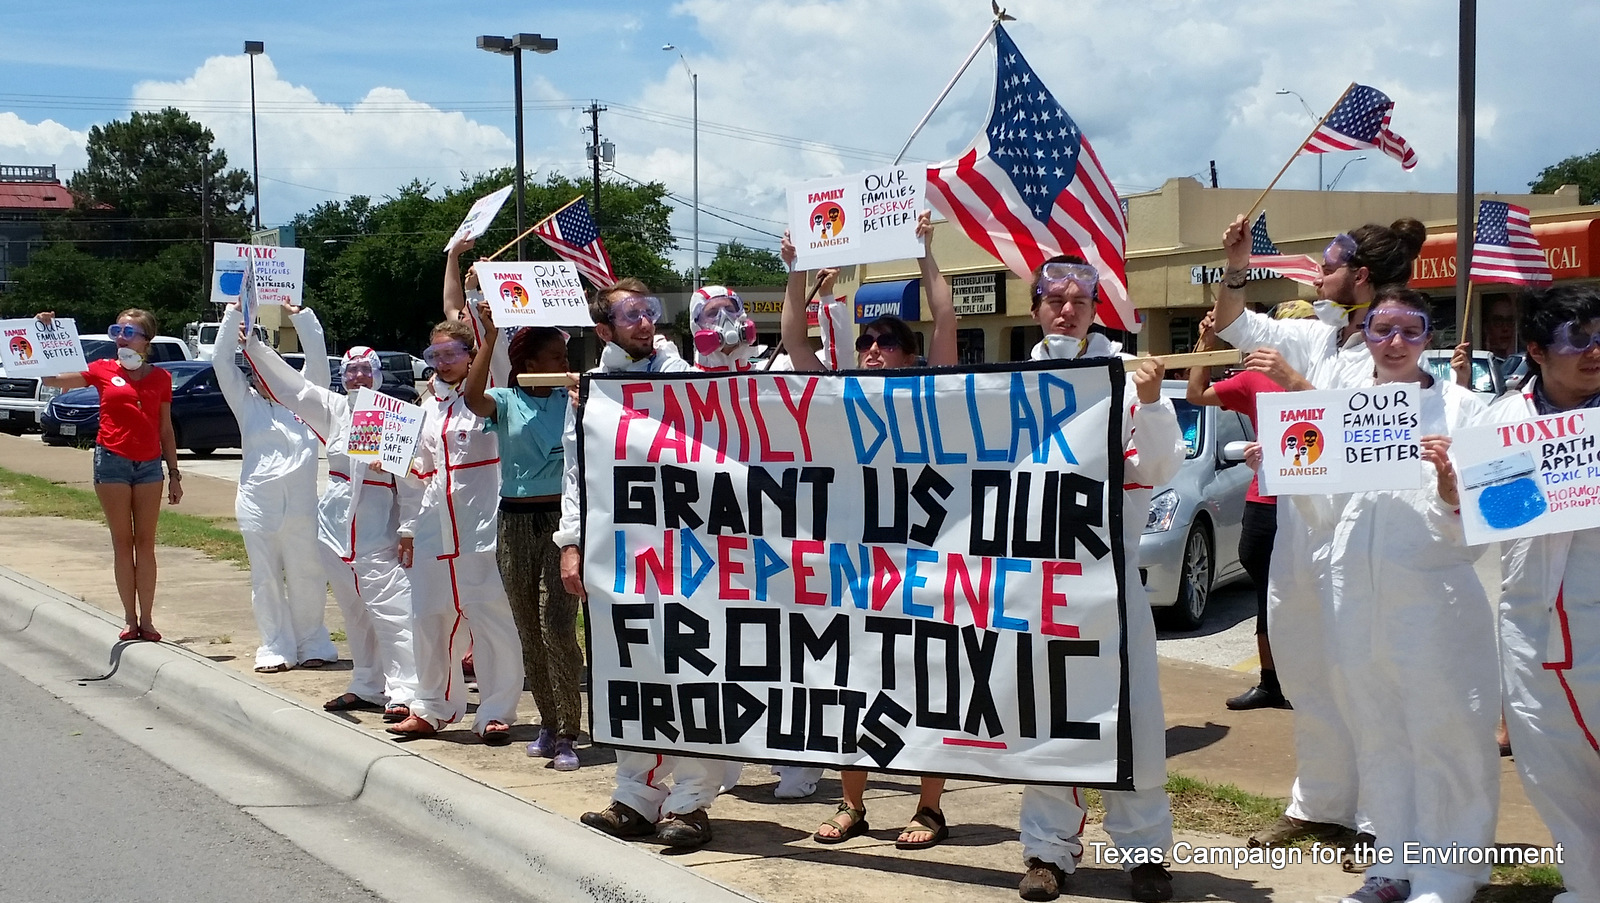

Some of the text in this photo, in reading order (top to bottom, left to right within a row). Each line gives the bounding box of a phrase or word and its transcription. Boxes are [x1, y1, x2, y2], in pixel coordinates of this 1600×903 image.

[864, 170, 908, 191] OUR
[808, 188, 844, 204] FAMILY
[861, 185, 916, 206] FAMILIES
[863, 198, 914, 218] DESERVE
[864, 210, 916, 233] BETTER!
[810, 236, 850, 249] DANGER
[1544, 246, 1581, 270] ICAL
[534, 265, 570, 278] OUR
[1206, 268, 1226, 283] TA
[1412, 255, 1456, 280] TEXAS
[535, 278, 580, 288] FAMILIES
[540, 288, 576, 297] DESERVE
[542, 296, 585, 308] BETTER!
[864, 302, 900, 318] EZPAWN
[35, 320, 64, 332] OUR
[36, 332, 70, 341] FAMILIES
[41, 340, 73, 349] DESERVE
[43, 347, 78, 359] BETTER!
[373, 393, 404, 415] TOXIC
[1348, 390, 1409, 411] OUR
[614, 372, 1078, 466] FAMILY DOLLAR
[1280, 408, 1326, 422] FAMILY
[1343, 412, 1418, 428] FAMILIES
[1344, 428, 1411, 443] DESERVE
[1497, 413, 1585, 447] TOXIC
[385, 433, 413, 444] 65 TIMES
[383, 444, 402, 454] SAFE
[1346, 444, 1420, 463] BETTER
[1542, 435, 1594, 459] BATH
[383, 453, 403, 464] LIMIT
[1280, 467, 1327, 476] DANGER
[1542, 469, 1581, 485] TOXIC
[614, 464, 1111, 560] GRANT US OUR
[614, 527, 1082, 638] INDEPENDENCE
[612, 602, 1100, 740] FROM TOXIC
[608, 678, 912, 768] PRODUCTS
